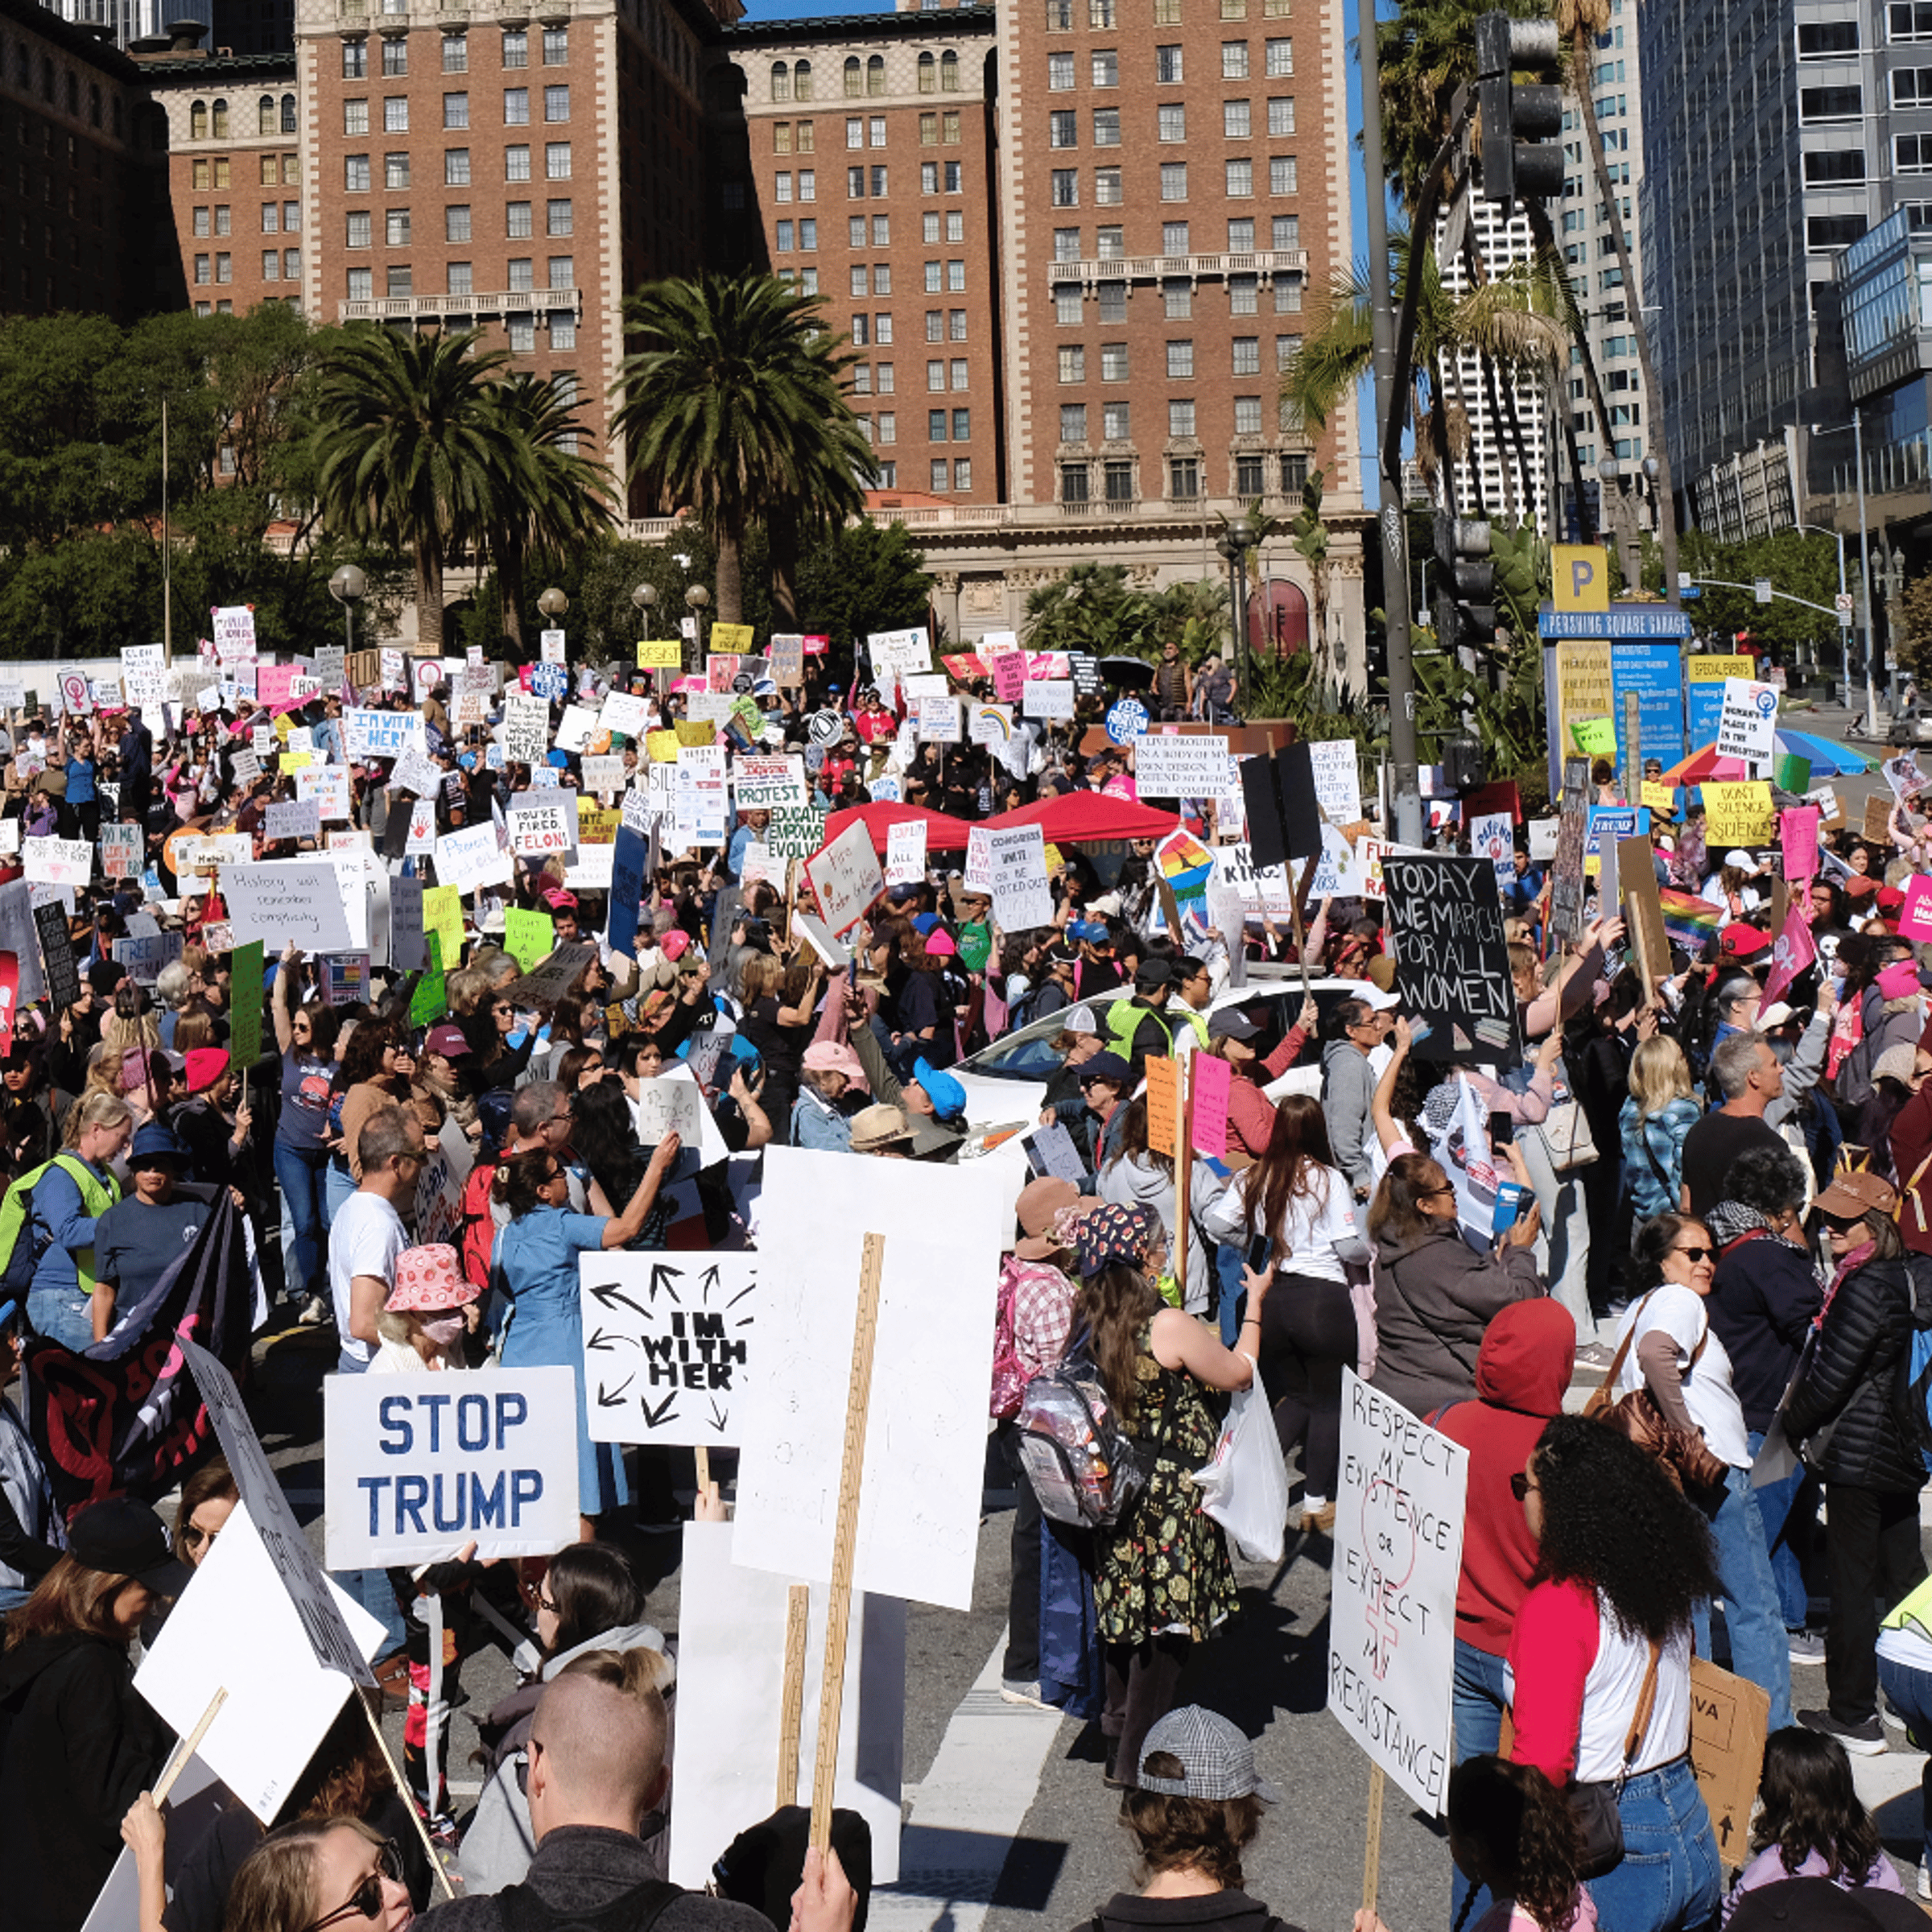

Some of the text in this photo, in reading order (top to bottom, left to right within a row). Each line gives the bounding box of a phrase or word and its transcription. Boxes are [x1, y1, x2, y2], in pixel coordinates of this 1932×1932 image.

[1571, 560, 1593, 597] P
[1550, 615, 1687, 636] PERSHING SQUARE GARAGE
[640, 646, 679, 660] RESIST
[1695, 663, 1749, 675] SPECIAL EVENTS
[382, 715, 415, 729] WITH
[1724, 707, 1761, 720] WOMAN'S
[1722, 718, 1758, 733] PLACE IS
[1146, 738, 1169, 747] LIVE
[1172, 738, 1224, 747] PROUDLY
[1721, 732, 1747, 743] IN THE
[1137, 749, 1227, 759] IN A BODY OF MY
[1137, 763, 1163, 772] OWN
[1217, 763, 1222, 771] I
[1137, 774, 1181, 782] DEFEND
[1198, 774, 1227, 783] RIGHT
[737, 785, 800, 803] PROTEST
[1137, 786, 1227, 795] TO BE COMPLEX
[1315, 782, 1349, 794] UNTRY
[1720, 786, 1755, 801] DON'T
[515, 808, 557, 820] YOU'RE
[770, 806, 826, 823] EDUCATE
[1716, 801, 1765, 814] SILENCE
[519, 821, 561, 832] FIRED.
[515, 832, 567, 850] FELON!
[991, 830, 1041, 847] CONGRESS
[893, 852, 912, 865] ALL
[1235, 848, 1249, 866] N
[234, 874, 320, 893] History will
[995, 868, 1027, 882] OR BE
[1383, 862, 1480, 902] TODAY
[993, 877, 1047, 895] VOTED OUT
[257, 894, 312, 906] remember
[1388, 895, 1504, 945] WE MARCH
[513, 931, 535, 942] LIKE
[122, 940, 152, 960] FREE
[519, 944, 528, 953] A
[1393, 929, 1502, 978] FOR ALL
[1397, 970, 1510, 1018] WOMEN
[671, 1312, 726, 1340] I'M
[641, 1335, 747, 1365] WITH
[649, 1360, 733, 1392] HER
[379, 1393, 527, 1455] STOP
[1352, 1383, 1455, 1476] RESPECT
[1379, 1447, 1404, 1484] MY
[357, 1469, 543, 1537] TRUMP
[1346, 1455, 1451, 1550] EXISTENCE
[1378, 1533, 1393, 1557] OR
[1347, 1548, 1430, 1635] EXPECT
[1363, 1638, 1389, 1678] MY
[1331, 1652, 1445, 1797] RESISTANCE
